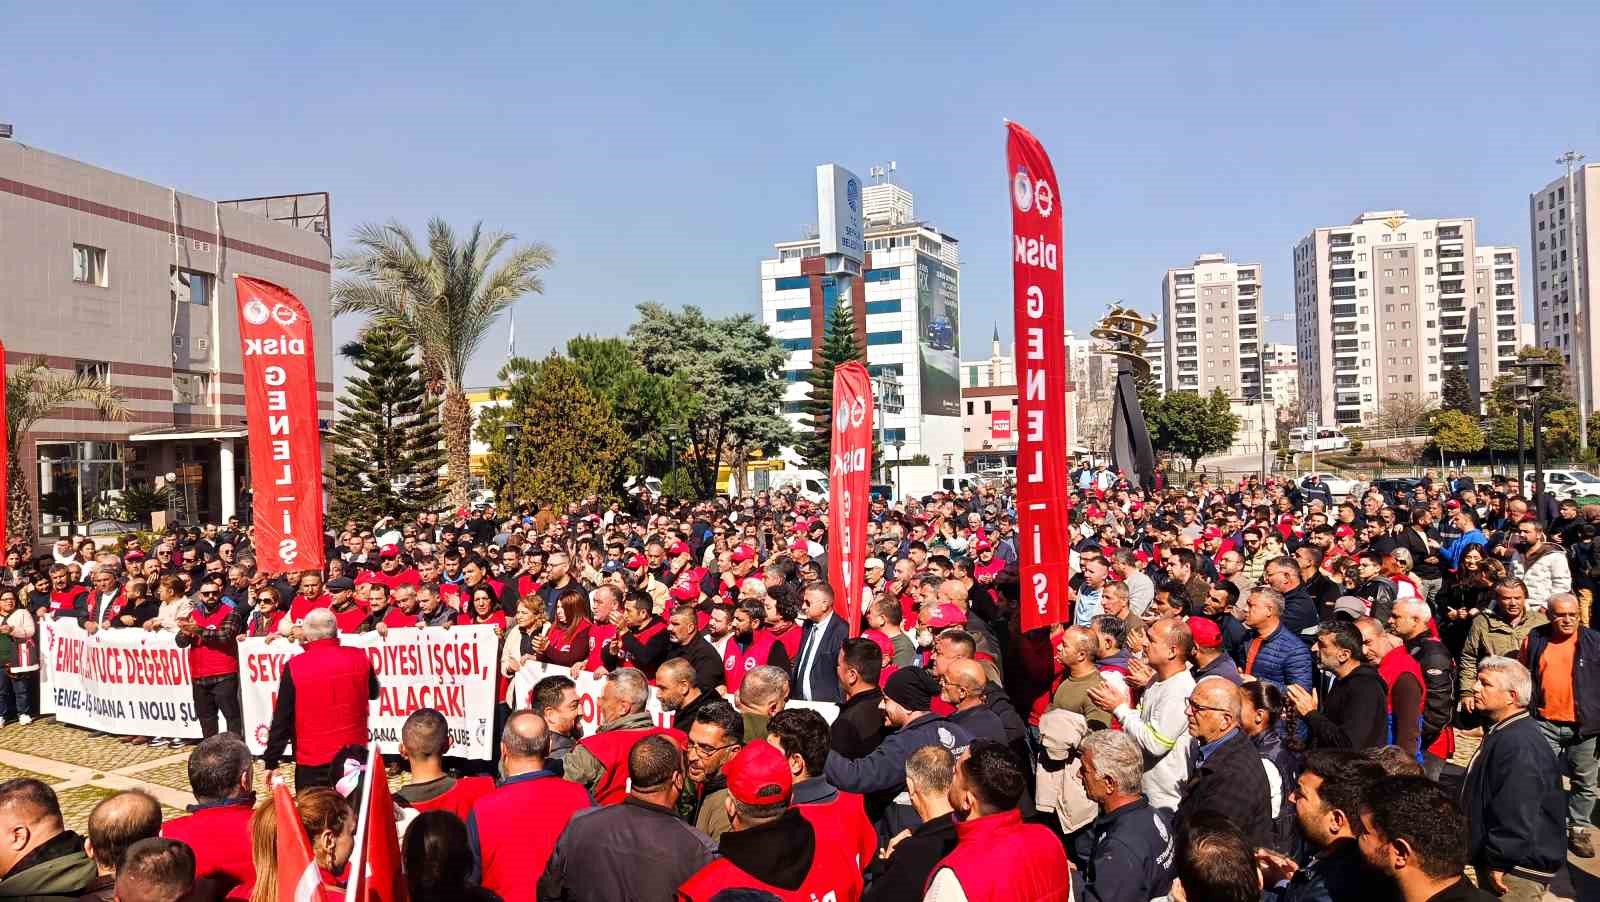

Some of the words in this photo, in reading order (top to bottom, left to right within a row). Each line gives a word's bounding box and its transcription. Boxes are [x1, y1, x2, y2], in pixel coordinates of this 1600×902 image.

[427, 633, 488, 684] İŞÇİSİ,
[129, 701, 135, 719] 1
[140, 702, 176, 721] NOLU
[180, 703, 199, 727] ŞU
